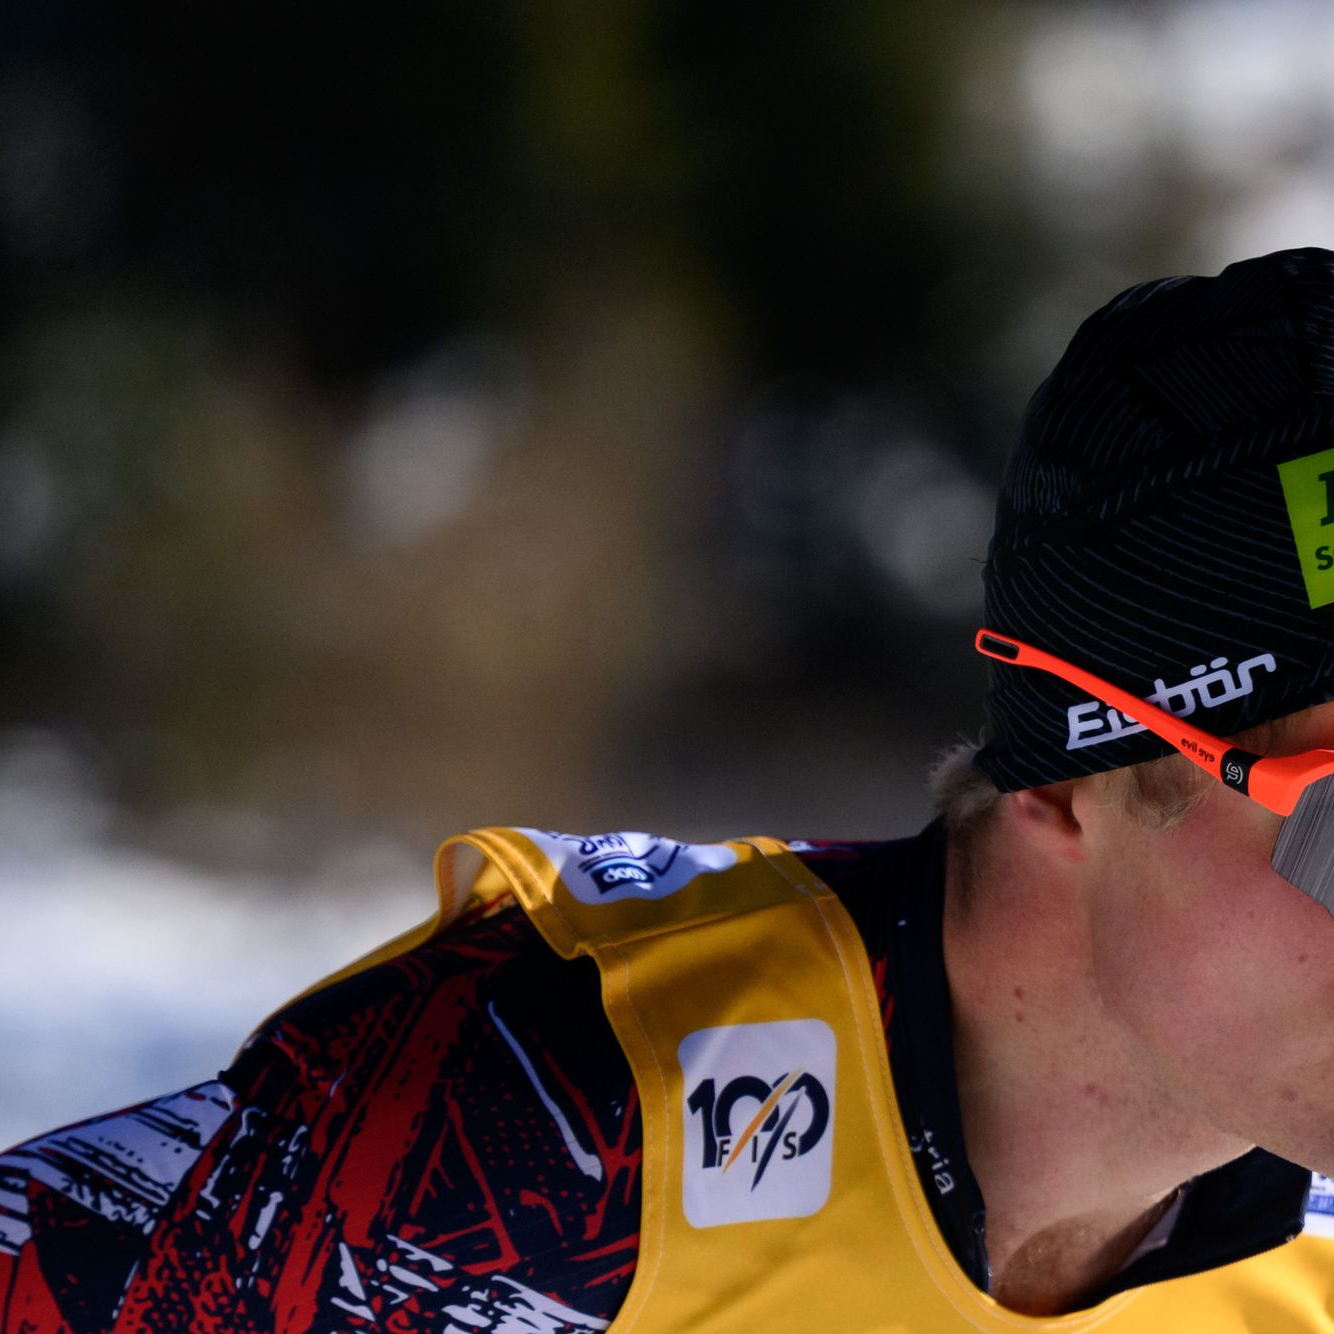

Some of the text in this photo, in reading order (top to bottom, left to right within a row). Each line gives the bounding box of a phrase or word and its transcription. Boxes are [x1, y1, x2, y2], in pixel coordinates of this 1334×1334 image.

[1066, 653, 1277, 750] Eibär
[1180, 737, 1198, 753] evil
[717, 1131, 797, 1168] FIS
